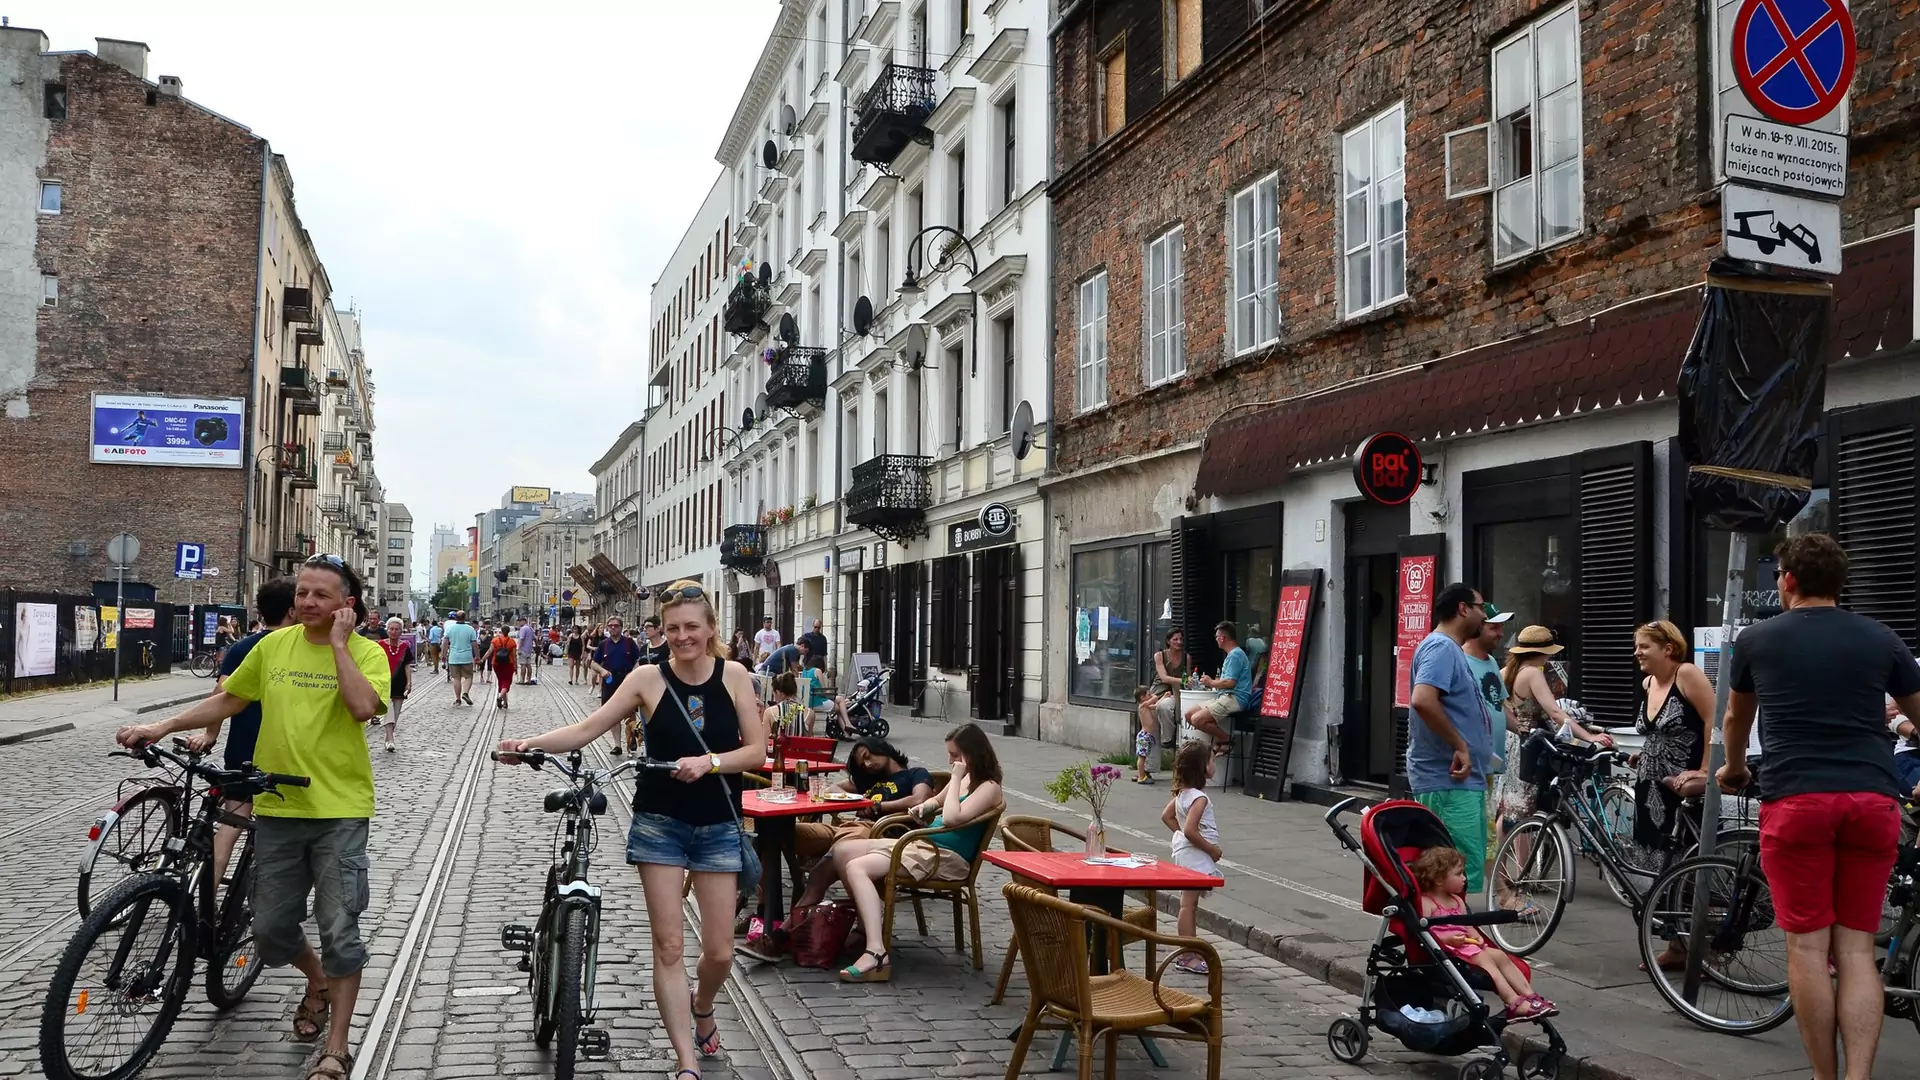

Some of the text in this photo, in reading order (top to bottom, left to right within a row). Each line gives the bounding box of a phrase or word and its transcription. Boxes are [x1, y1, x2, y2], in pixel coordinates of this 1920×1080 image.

[1741, 125, 1752, 137] W
[1730, 142, 1843, 173] także na wyznaczonych
[1728, 160, 1843, 190] miejscach postojowych
[193, 403, 229, 411] Panasonic
[180, 544, 200, 570] P
[1405, 615, 1425, 630] LUNCH
[292, 680, 319, 688] Trzcianka
